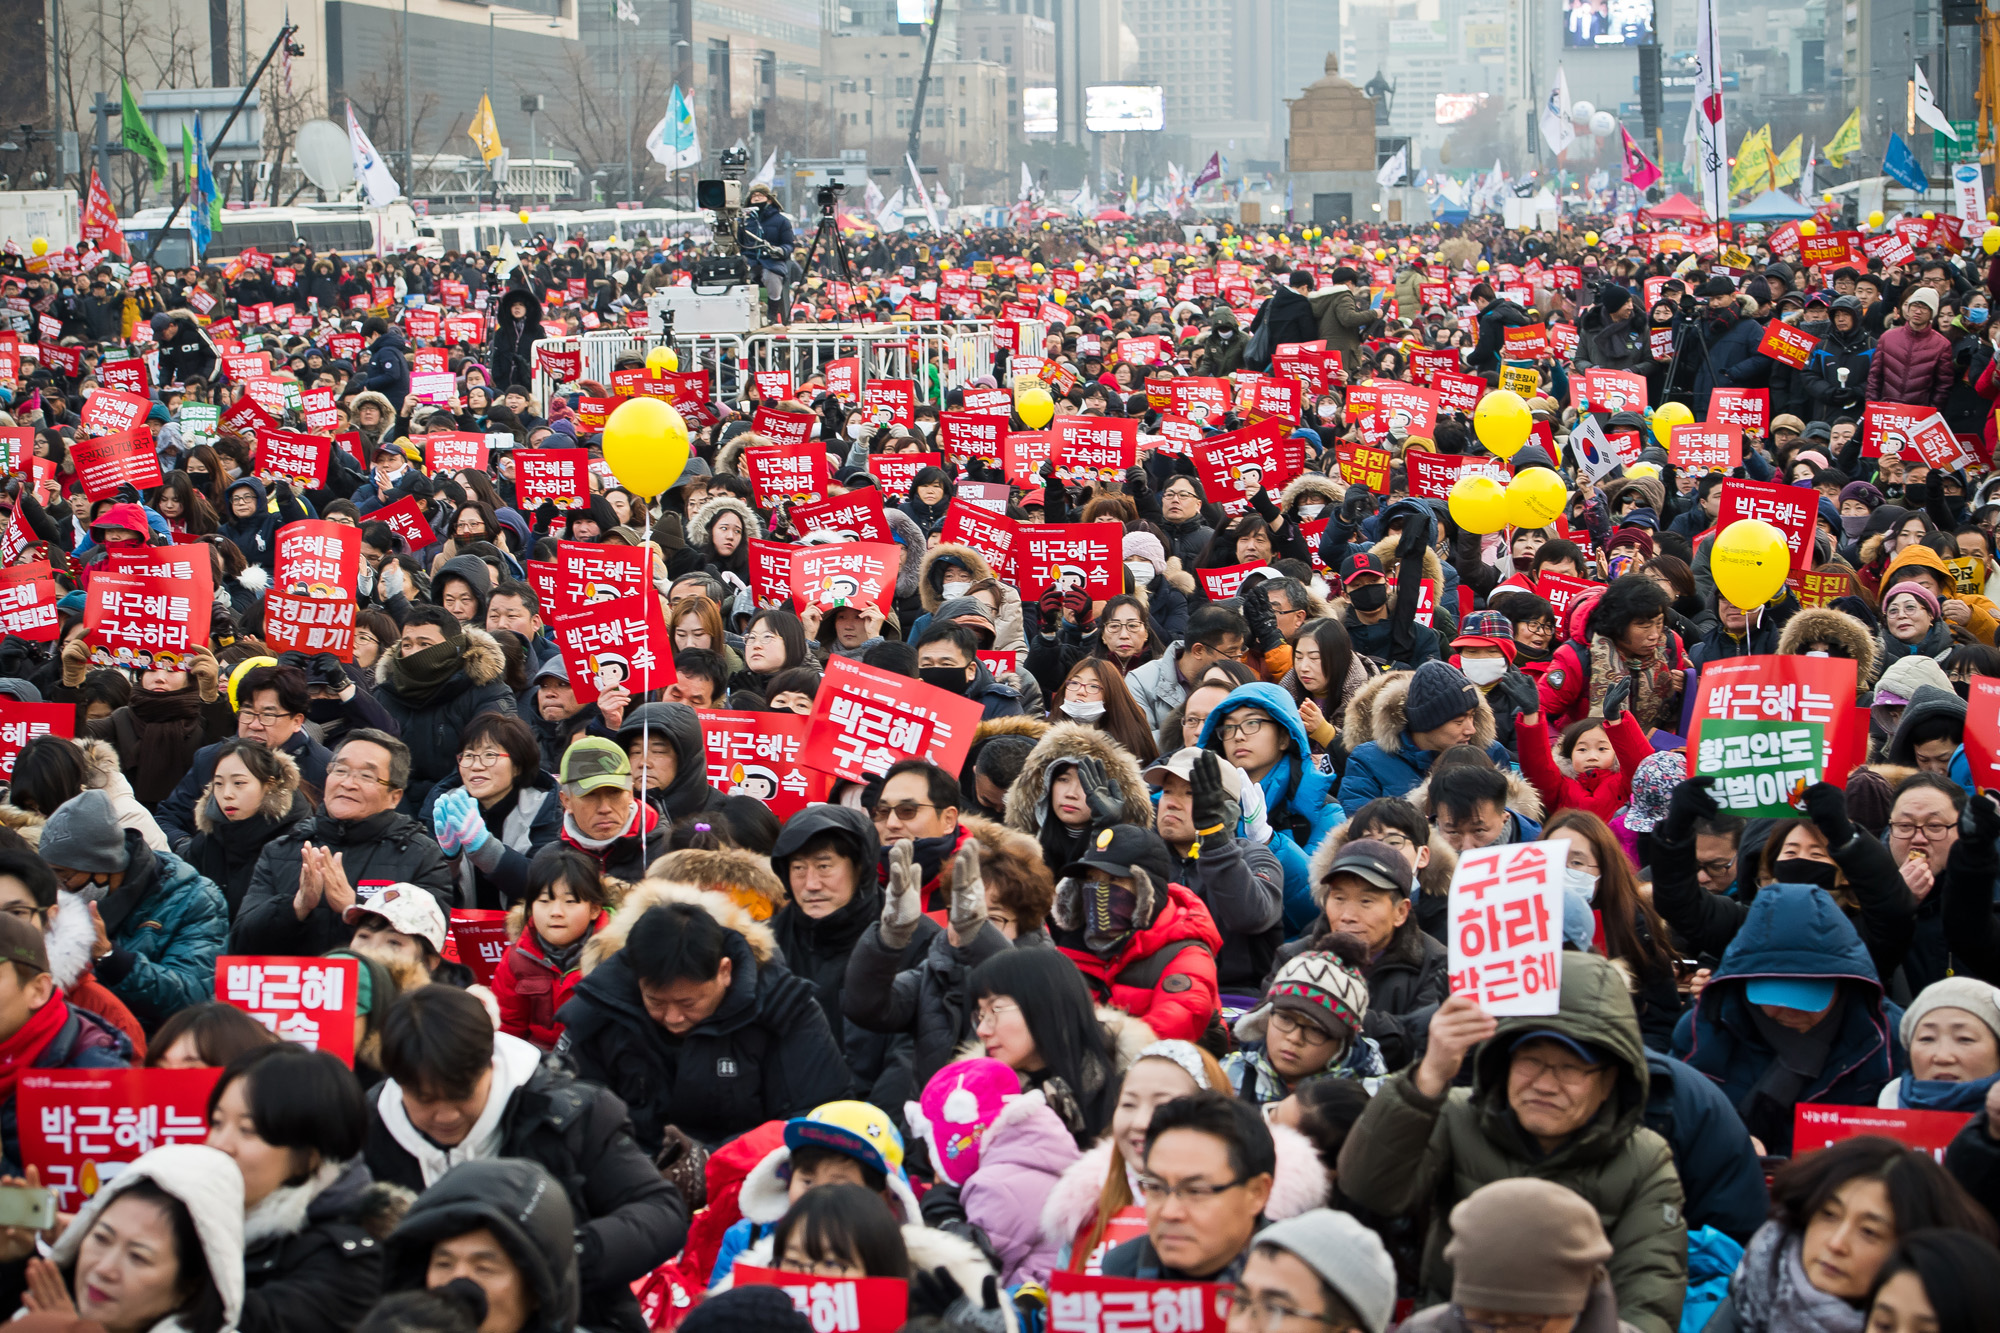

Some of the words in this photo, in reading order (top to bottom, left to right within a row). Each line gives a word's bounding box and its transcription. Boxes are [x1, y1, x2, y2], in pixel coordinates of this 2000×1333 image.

[1808, 237, 1838, 248] 박근혜
[1804, 247, 1845, 260] 즉각퇴진!
[1778, 328, 1813, 351] 박근혜
[1280, 362, 1320, 376] 박근혜는
[644, 383, 676, 393] 박근혜
[762, 386, 783, 398] 구속
[1176, 386, 1223, 401] 박근혜는
[1440, 379, 1478, 396] 박근혜를
[1593, 377, 1639, 393] 박근혜는
[95, 396, 138, 418] 박근혜를
[1381, 393, 1429, 412] 박근혜는
[1439, 394, 1477, 408] 구속하라
[1719, 397, 1763, 411] 박근혜를
[89, 409, 132, 429] 구속하라
[764, 418, 807, 435] 박근혜를
[1717, 411, 1762, 427] 구속하라
[949, 422, 997, 440] 박근혜를
[1063, 427, 1123, 447] 박근혜를
[1679, 434, 1730, 448] 박근혜를
[267, 438, 318, 461] 박근혜를
[434, 440, 479, 455] 박근혜를
[950, 439, 997, 456] 구속하라
[1061, 448, 1122, 467] 구속하라
[1206, 436, 1274, 467] 박근혜는
[1354, 448, 1390, 468] 퇴진!
[265, 454, 317, 477] 구속하라
[433, 455, 477, 468] 구속하라
[523, 460, 575, 477] 박근혜를
[756, 455, 813, 474] 박근혜를
[1677, 452, 1730, 465] 구속하라
[761, 473, 814, 491] 구속하라
[1339, 460, 1382, 491] 박근혜
[524, 479, 576, 495] 구속하라
[1735, 497, 1806, 527] 박근혜는
[958, 515, 1013, 551] 박근혜를
[280, 534, 344, 564] 박근혜를
[1030, 539, 1109, 561] 박근혜는
[281, 561, 342, 588] 구속하라
[567, 557, 642, 585] 박근혜는
[803, 554, 885, 578] 박근혜는
[1088, 565, 1109, 586] 속
[1804, 575, 1847, 593] 퇴진!
[101, 590, 192, 621] 박근혜를
[267, 594, 355, 627] 국정교과서
[98, 620, 189, 650] 구속하라
[267, 618, 300, 646] 즉각
[306, 627, 350, 650] 폐기!
[566, 617, 649, 655] 박근혜는
[1708, 683, 1834, 722] 박근혜는
[828, 696, 925, 755] 박근혜
[707, 730, 800, 762] 박근혜는
[832, 734, 896, 779] 구속
[1698, 729, 1814, 773] 황교안도
[781, 768, 808, 796] 속
[1459, 846, 1547, 900] 구속
[1457, 893, 1549, 957] 하라
[227, 965, 344, 1011] 박근혜
[1449, 952, 1558, 1004] 박근혜
[41, 1105, 207, 1154] 박근혜는
[1840, 1117, 1906, 1128] www.nanum.com
[1051, 1287, 1205, 1333] 박근혜
